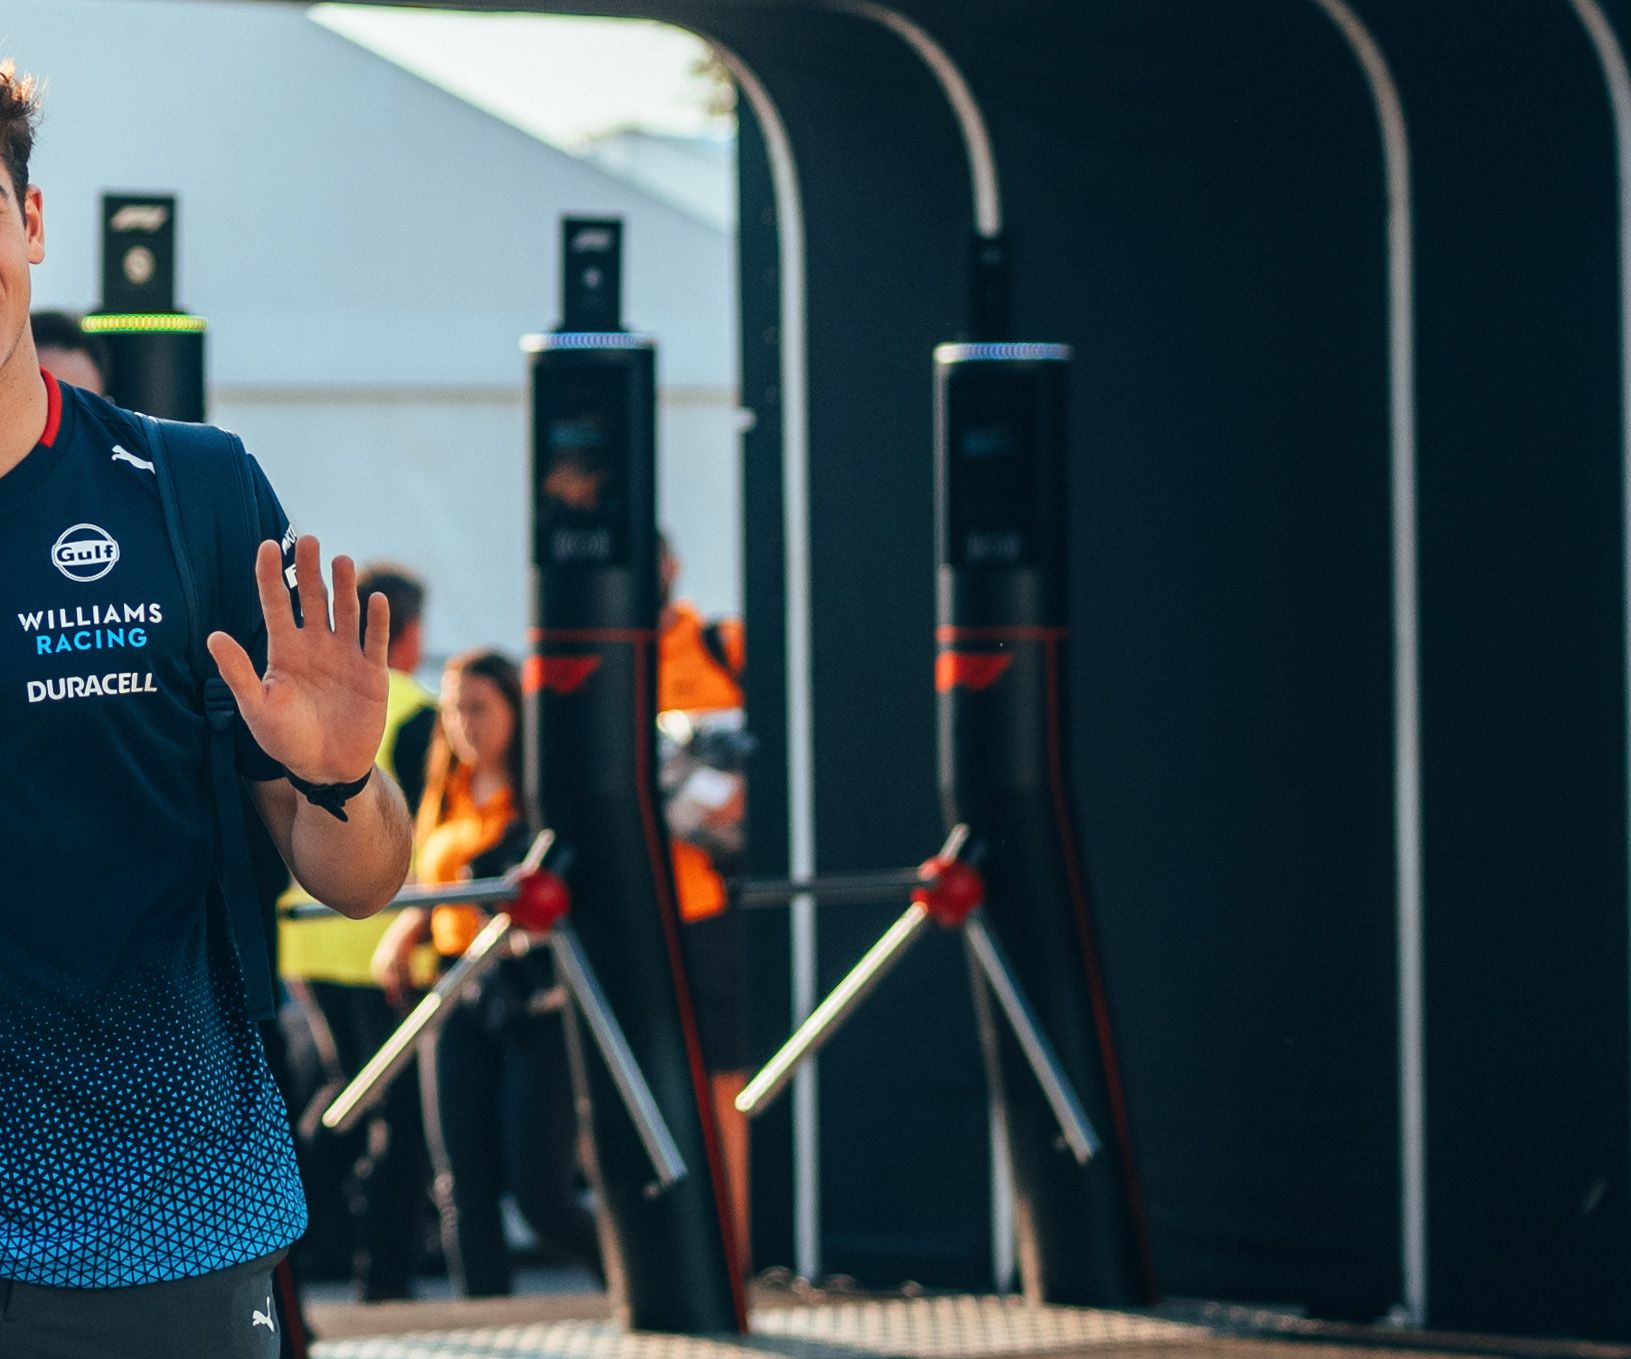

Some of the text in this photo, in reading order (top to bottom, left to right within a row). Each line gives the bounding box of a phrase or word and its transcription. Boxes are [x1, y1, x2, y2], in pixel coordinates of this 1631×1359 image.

[56, 544, 114, 563] Gulf
[17, 602, 163, 632] WILLIAMS
[36, 627, 148, 656] RACING
[26, 672, 158, 703] DURACELL
